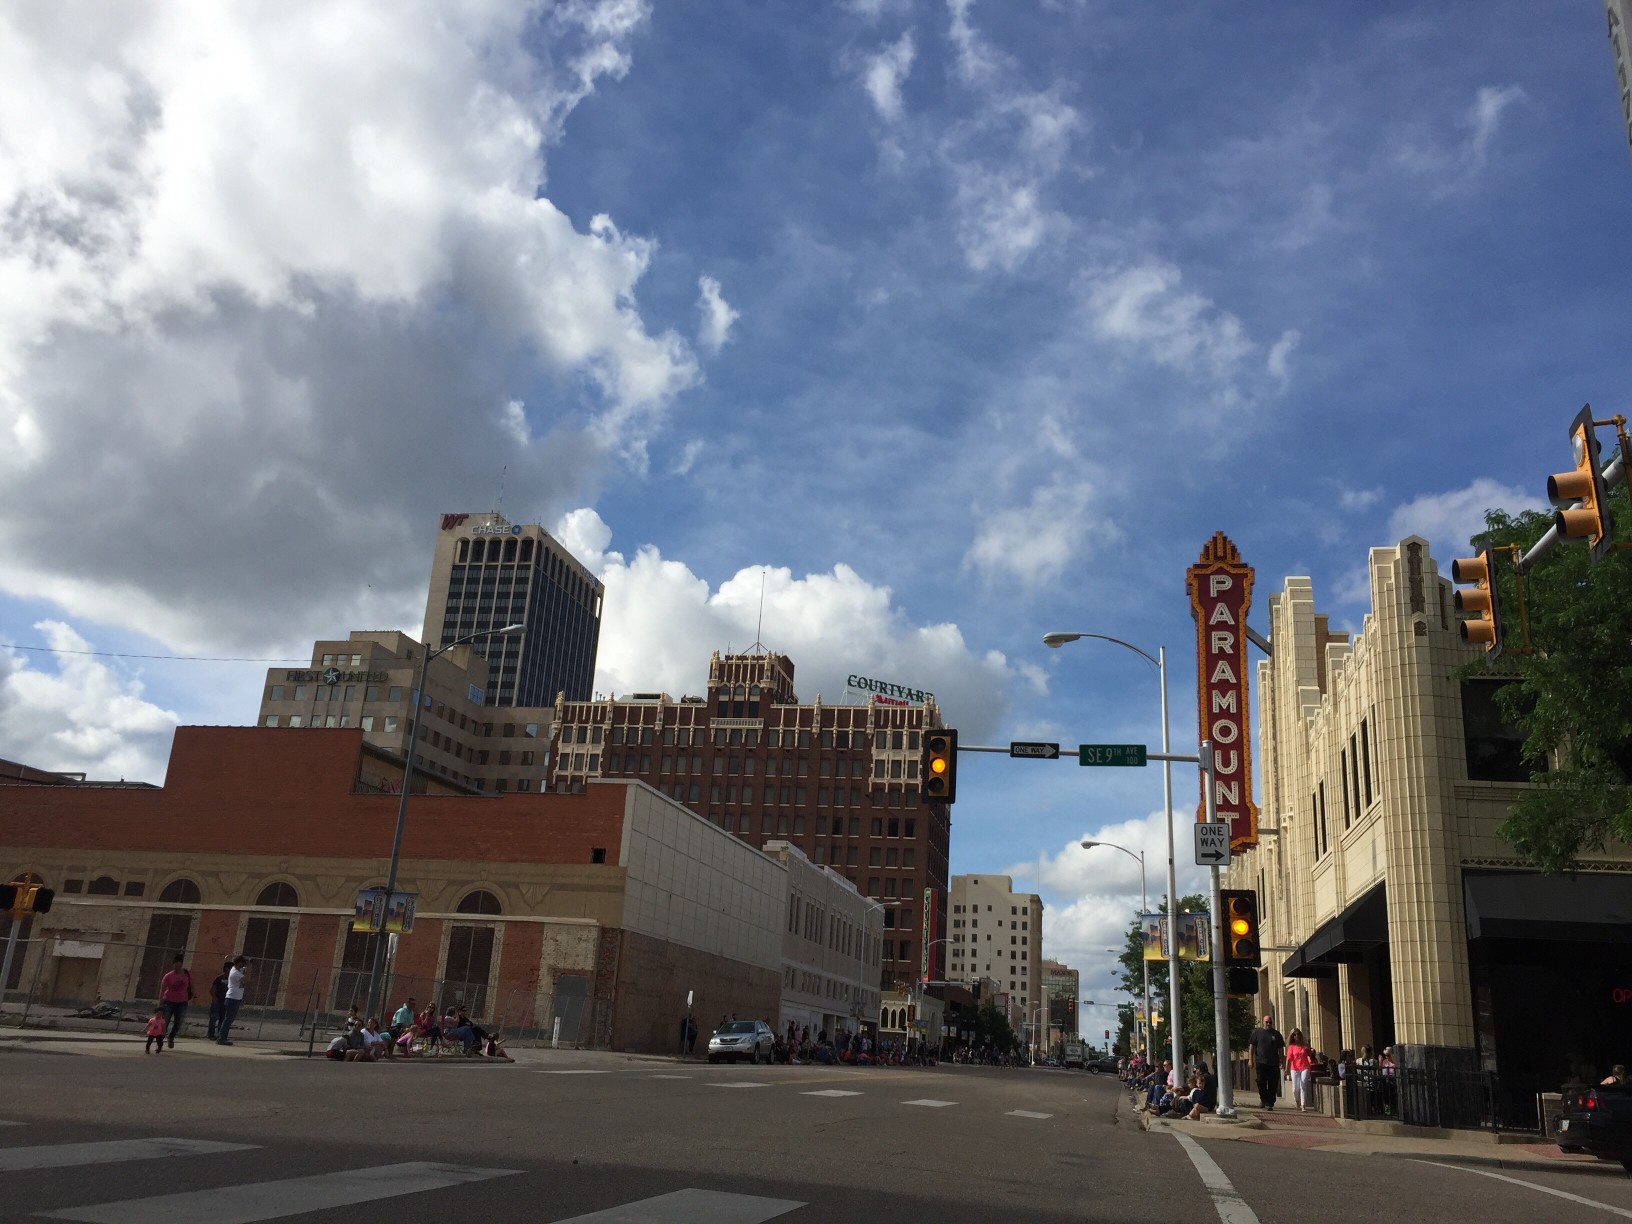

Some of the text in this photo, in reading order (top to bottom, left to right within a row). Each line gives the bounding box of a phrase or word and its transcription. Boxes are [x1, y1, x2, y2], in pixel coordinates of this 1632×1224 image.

[471, 525, 510, 534] CHASE
[286, 670, 389, 683] FIRST UNITED
[1210, 574, 1240, 837] PARAMOUNT
[1015, 746, 1029, 754] ONE
[1088, 747, 1103, 763] SE
[1125, 747, 1138, 755] AVE
[1201, 826, 1224, 836] ONE
[1200, 838, 1225, 848] WAY
